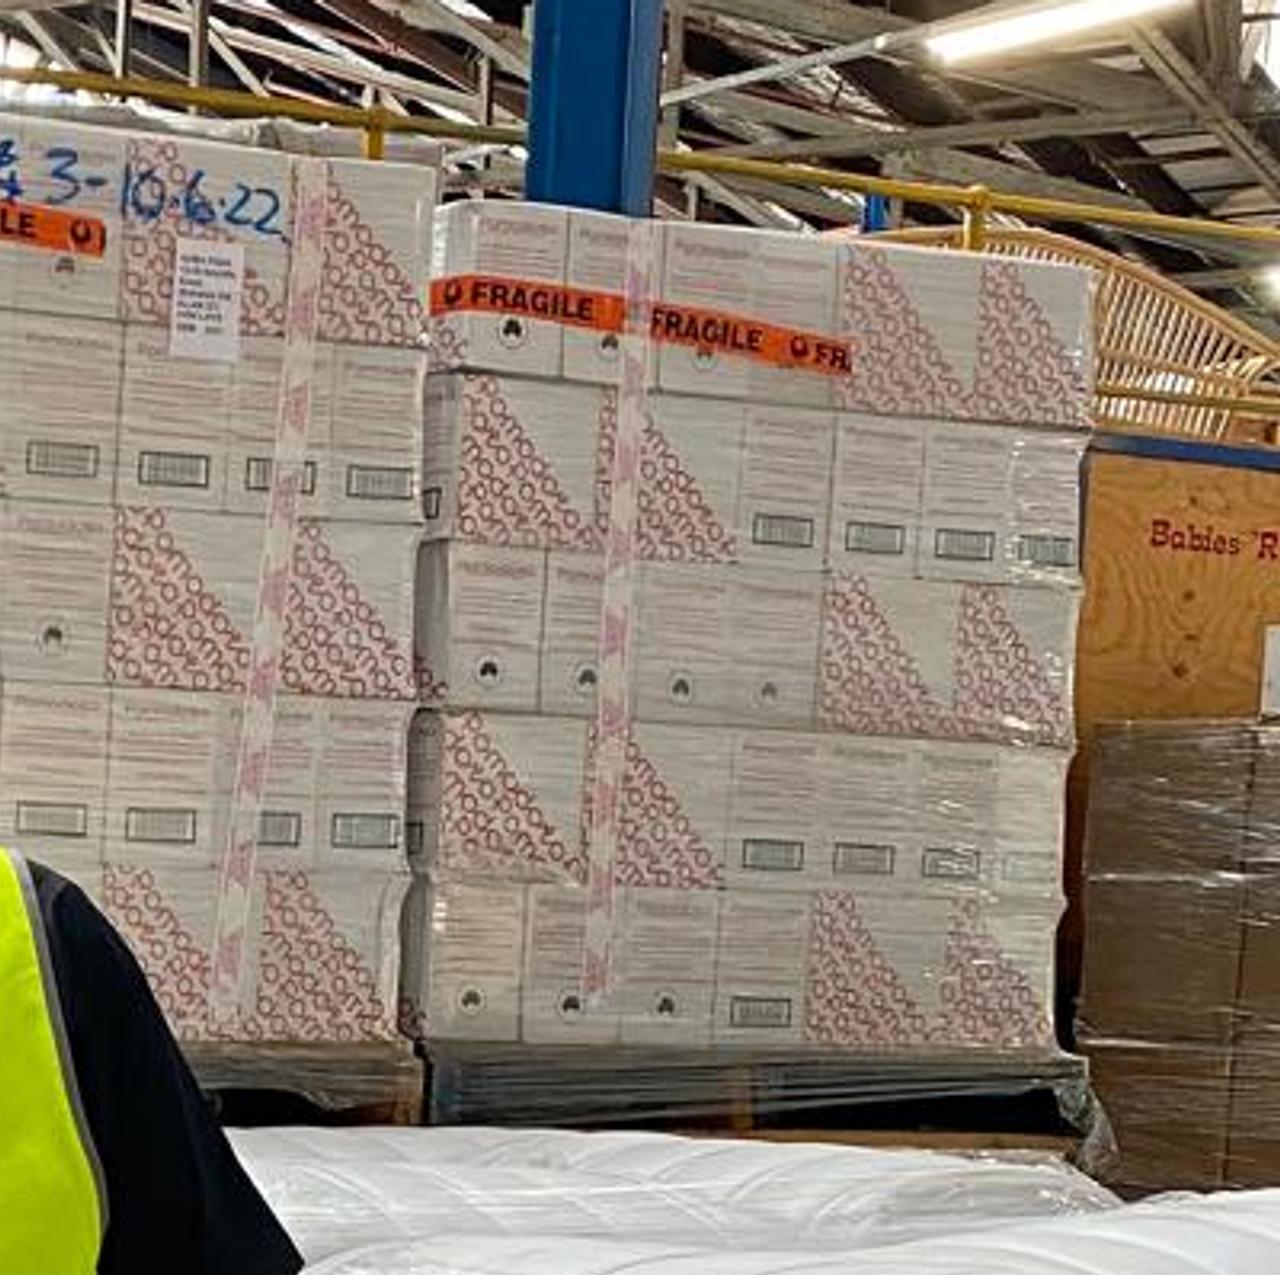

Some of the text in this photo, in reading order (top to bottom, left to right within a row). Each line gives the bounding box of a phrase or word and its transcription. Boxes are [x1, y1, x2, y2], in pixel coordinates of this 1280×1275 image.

[470, 281, 594, 322] FRAGILE
[651, 305, 764, 352] FRAGILE
[1150, 519, 1240, 556] Babies
